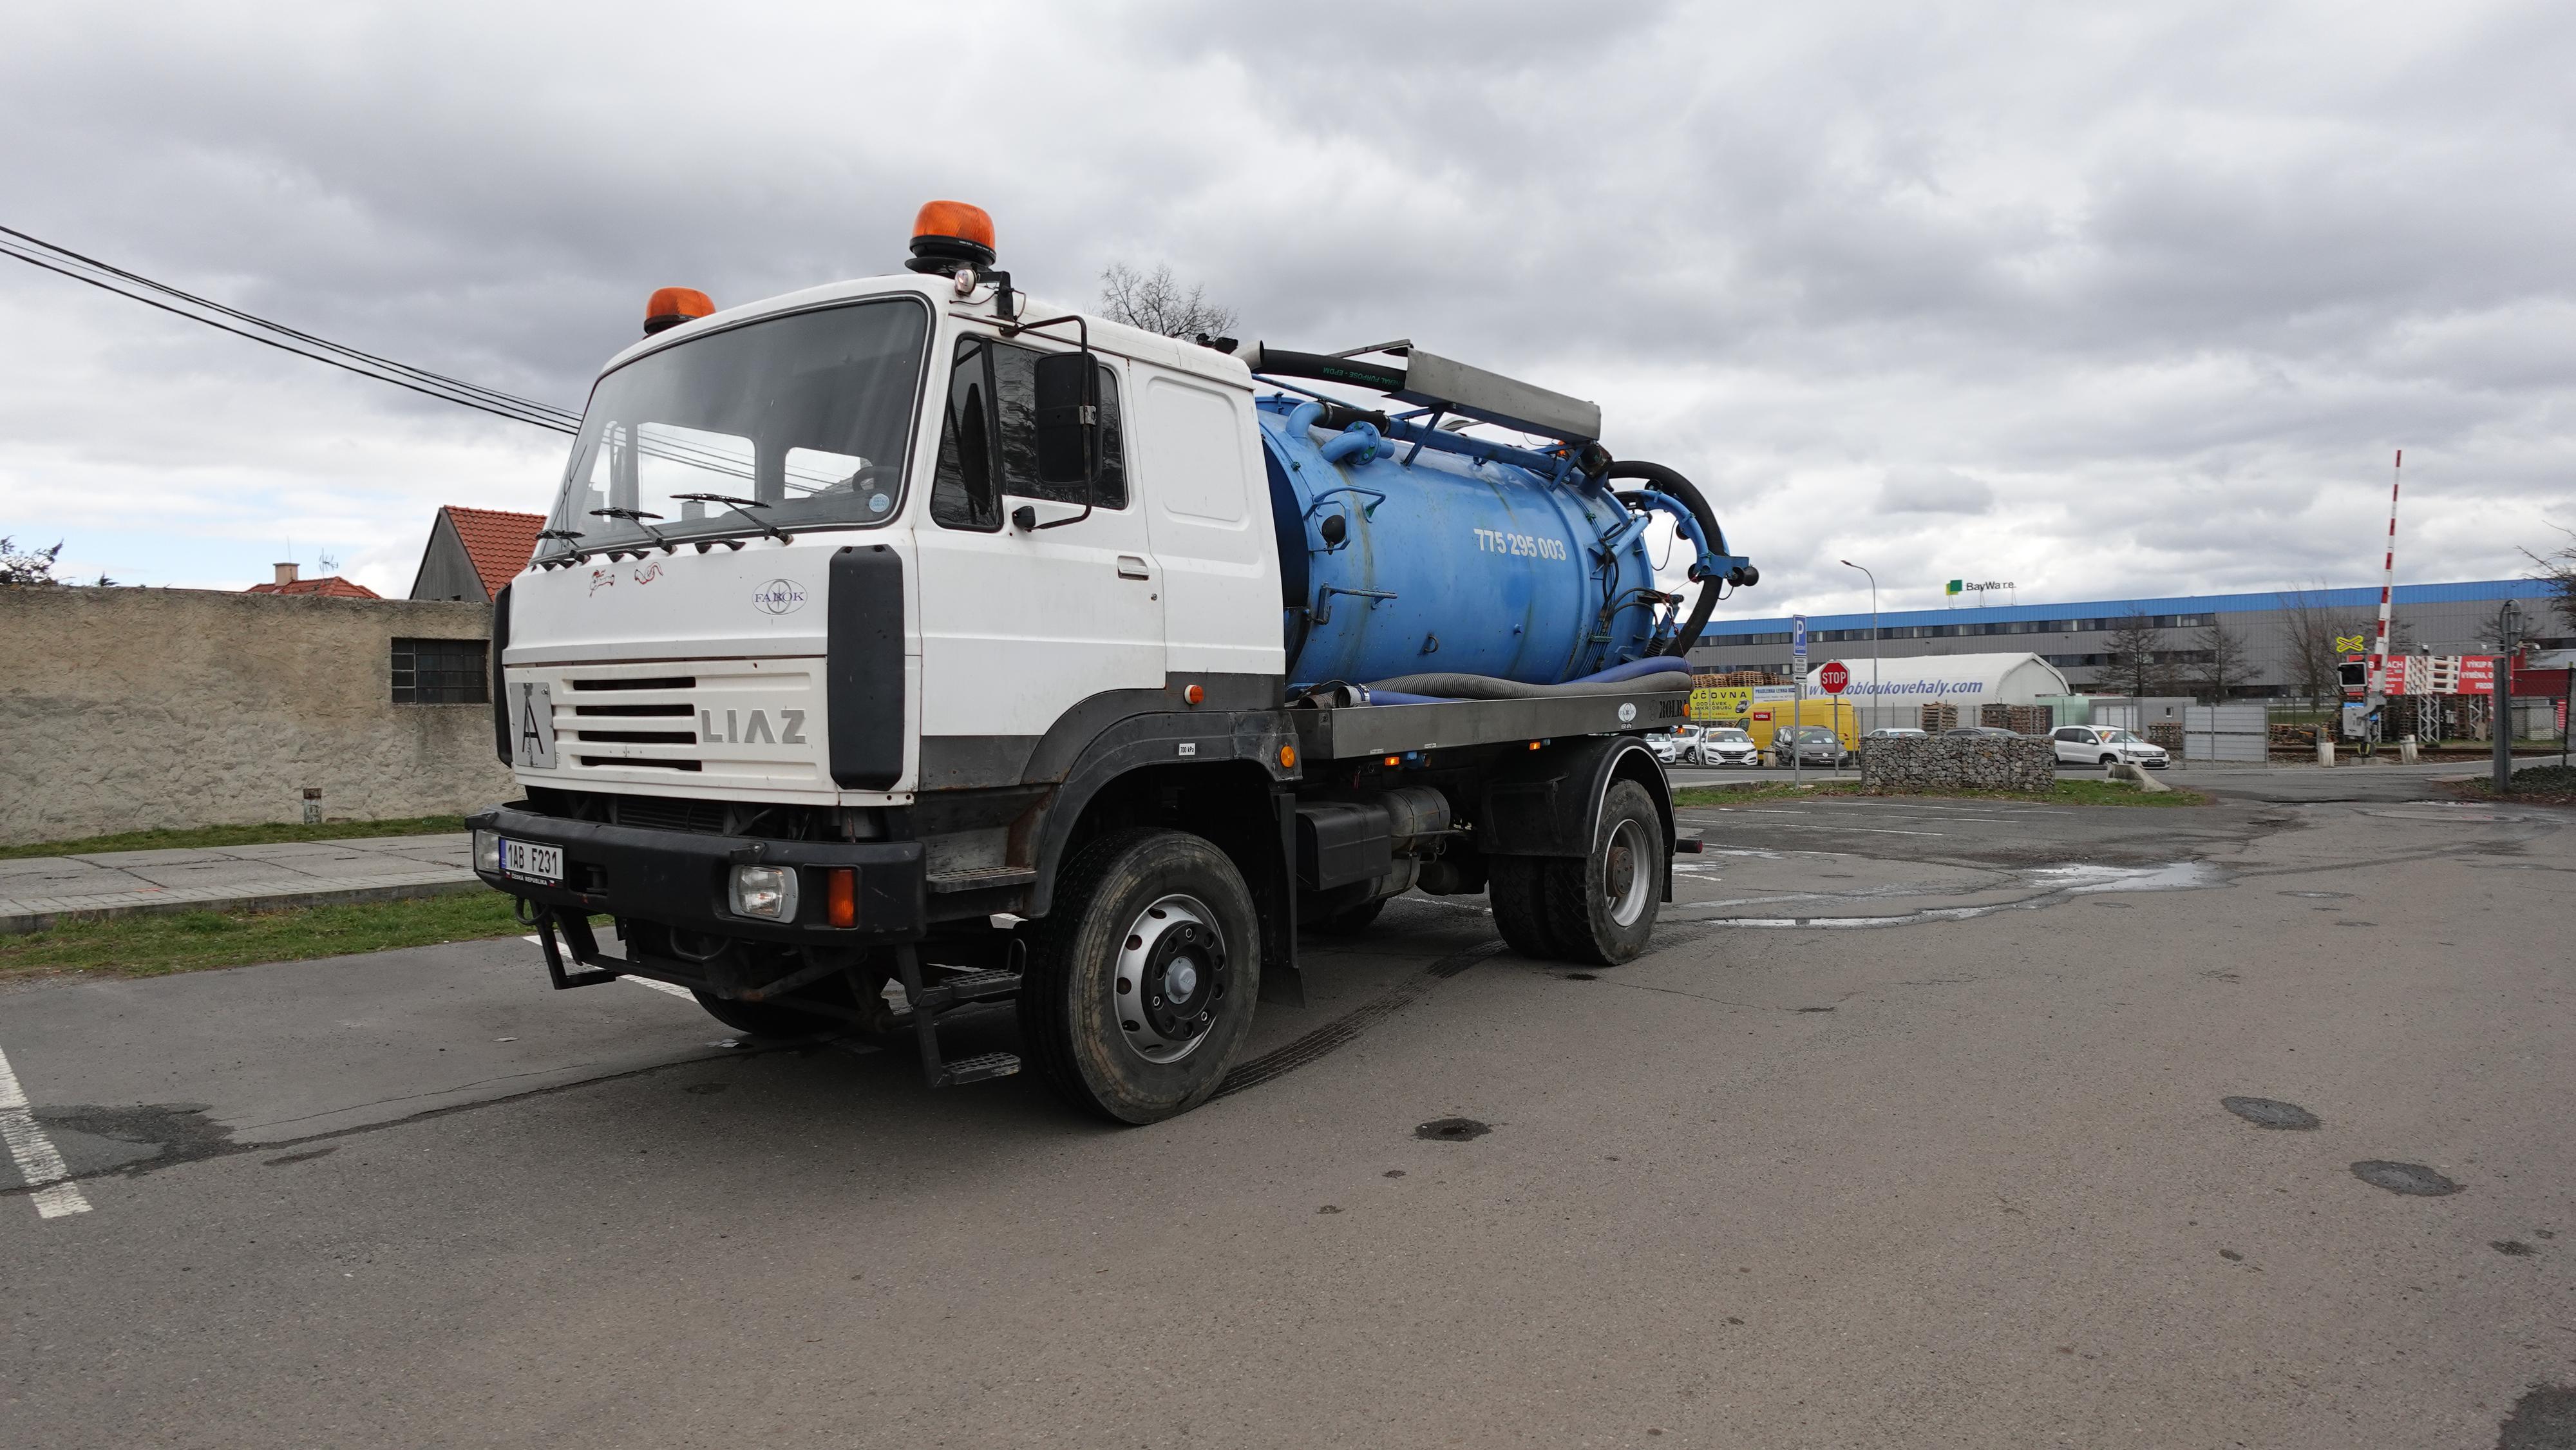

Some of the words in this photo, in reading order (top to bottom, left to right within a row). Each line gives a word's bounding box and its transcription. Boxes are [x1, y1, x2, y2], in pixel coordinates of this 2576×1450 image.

[1323, 367, 1344, 376] EPDM
[1349, 371, 1379, 383] PURPOSE
[1473, 528, 1507, 554] 775
[1507, 533, 1538, 558] 295
[1537, 537, 1567, 561] 003
[1966, 581, 2001, 593] BayWa
[1796, 620, 1804, 643] P
[1822, 671, 1847, 685] STOP
[522, 696, 544, 754] A
[701, 709, 808, 744] LIAZ
[508, 844, 525, 869] 1AB
[532, 848, 557, 875] F231
